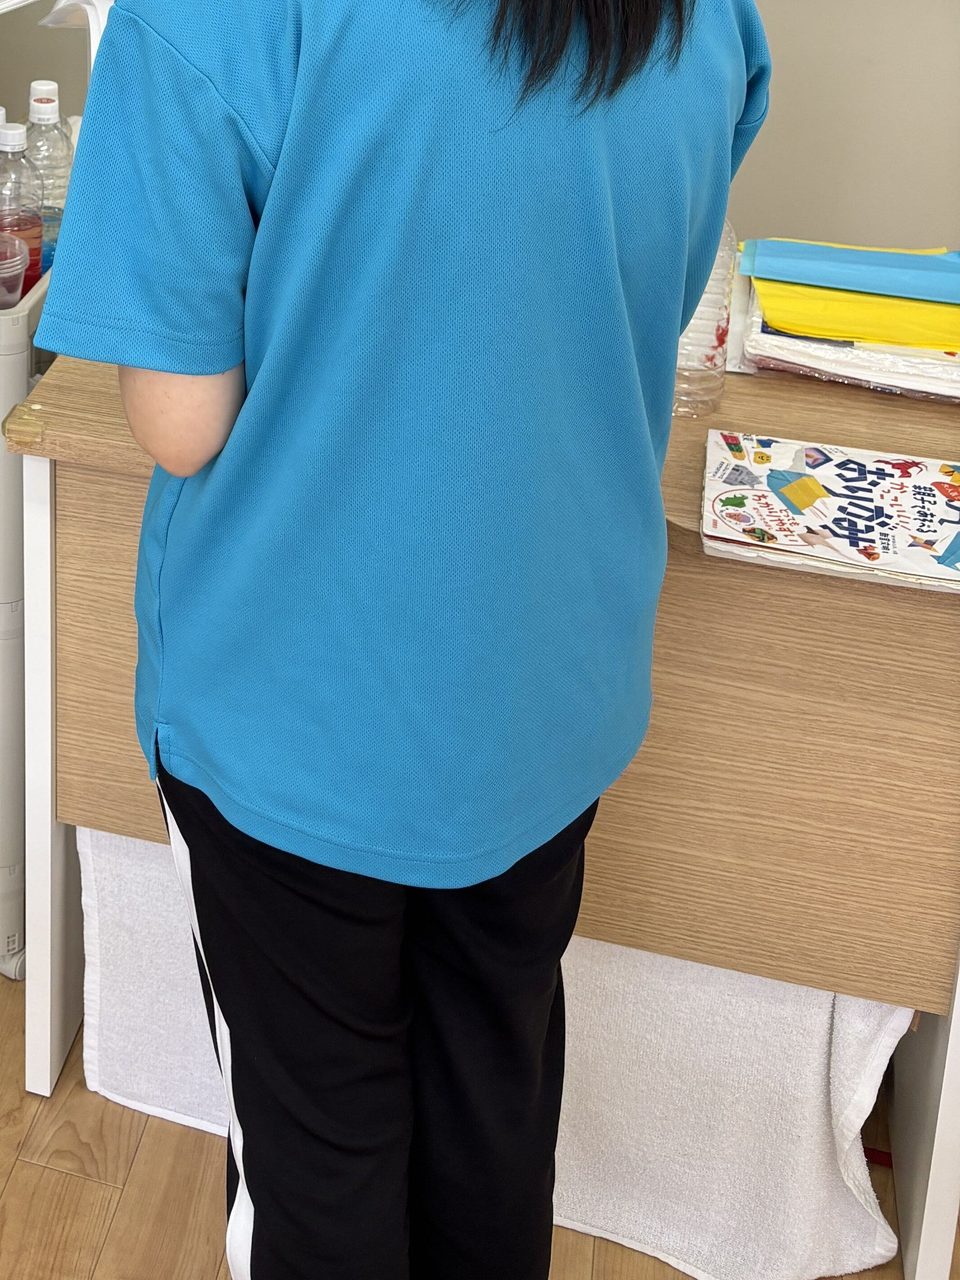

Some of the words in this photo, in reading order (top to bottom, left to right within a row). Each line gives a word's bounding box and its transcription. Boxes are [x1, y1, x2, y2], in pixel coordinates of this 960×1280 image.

[819, 458, 900, 549] おりがみ
[911, 484, 938, 533] 親子であそべる
